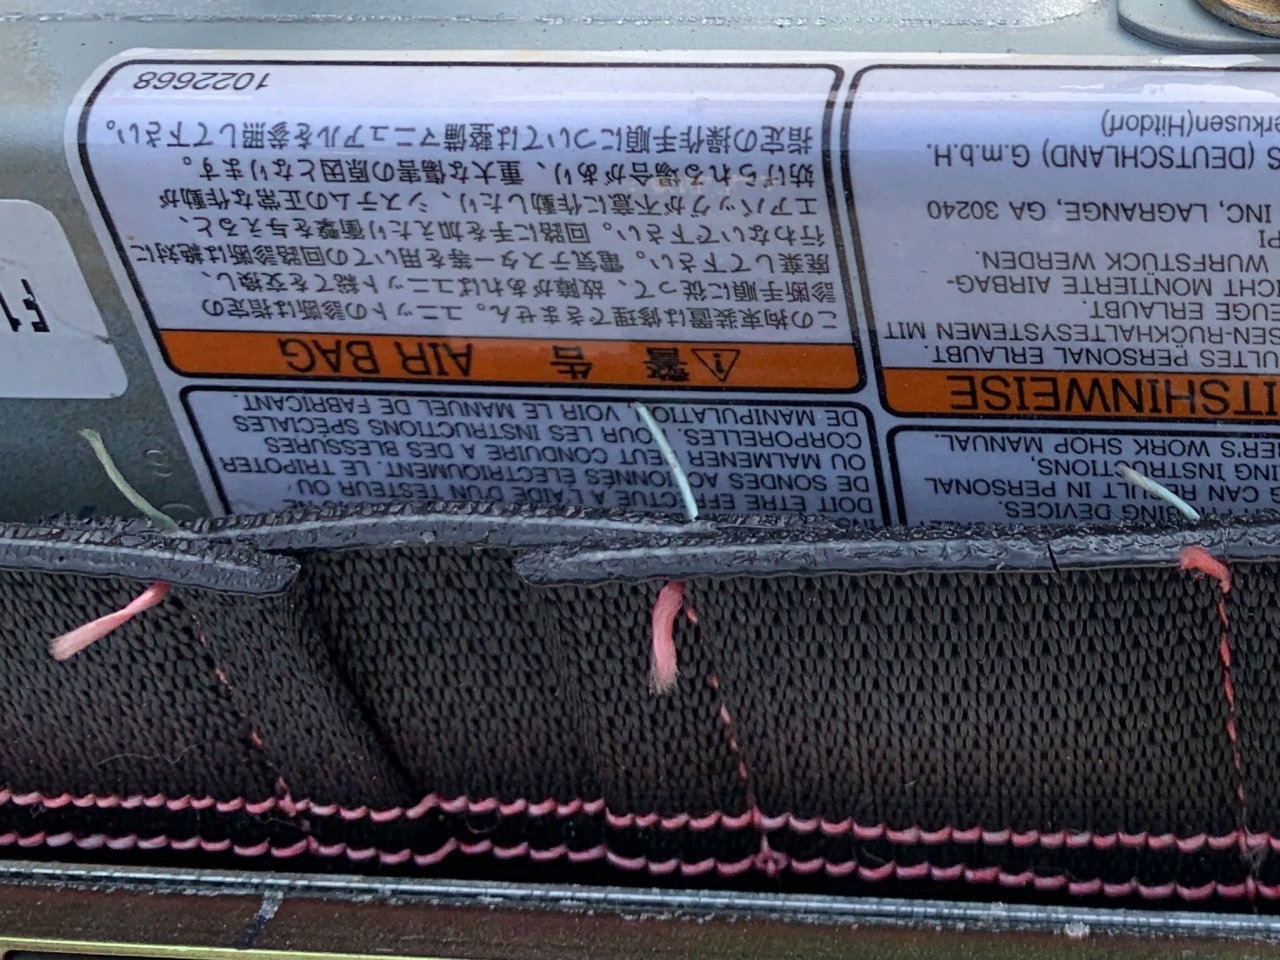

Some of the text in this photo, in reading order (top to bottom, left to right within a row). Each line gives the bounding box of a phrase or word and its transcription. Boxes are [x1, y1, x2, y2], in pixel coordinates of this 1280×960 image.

[132, 72, 270, 90] 1022668
[926, 144, 1030, 168] G.m.b.H.
[1042, 138, 1254, 170] (DEUTSCHLAND)
[927, 200, 999, 220] 30240
[1008, 202, 1046, 221] GA
[1056, 198, 1208, 223] LAGRANGE,
[1219, 200, 1272, 224] INC,
[976, 251, 1096, 270] WERDEN.
[1104, 252, 1269, 276] WURFSTÜCK
[946, 274, 1050, 294] AIRBAG-
[1062, 276, 1212, 296] MONTIERTE
[1082, 300, 1203, 320] ERLAUBT.
[884, 322, 926, 340] MIT
[278, 338, 472, 376] AIR BAG
[924, 346, 1044, 364] ERLAUBT.
[1053, 346, 1188, 366] PERSONAL
[234, 395, 371, 414] FABRICANT.
[378, 398, 411, 415] DE
[418, 400, 516, 418] MANUEL
[524, 403, 552, 420] LE
[561, 405, 620, 422] VOIR
[232, 415, 360, 437] SPÉCIALES
[825, 410, 858, 427] DE
[368, 419, 540, 440] INSTRUCTIONS
[548, 425, 593, 442] LES
[678, 429, 862, 449] CORPORELLES.
[264, 437, 400, 456] BLESSURES
[406, 442, 454, 458] DES
[936, 434, 1043, 453] MANUAL.
[1054, 437, 1122, 455] SHOP
[1134, 439, 1210, 457] WORK
[220, 457, 336, 476] TRIPOTER
[340, 460, 370, 476] LE
[687, 450, 821, 470] MALMENER
[831, 454, 866, 470] OU
[297, 480, 330, 496] OU
[584, 468, 718, 489] ACIONNÉS
[728, 473, 827, 492] SONDES
[836, 476, 869, 492] DE
[924, 478, 1056, 497] PERSONAL
[339, 480, 439, 500] TESTEUR
[1067, 482, 1091, 498] IN
[1208, 485, 1259, 503] CAN
[818, 496, 873, 514] DOIT
[998, 501, 1112, 520] DEVICES.
